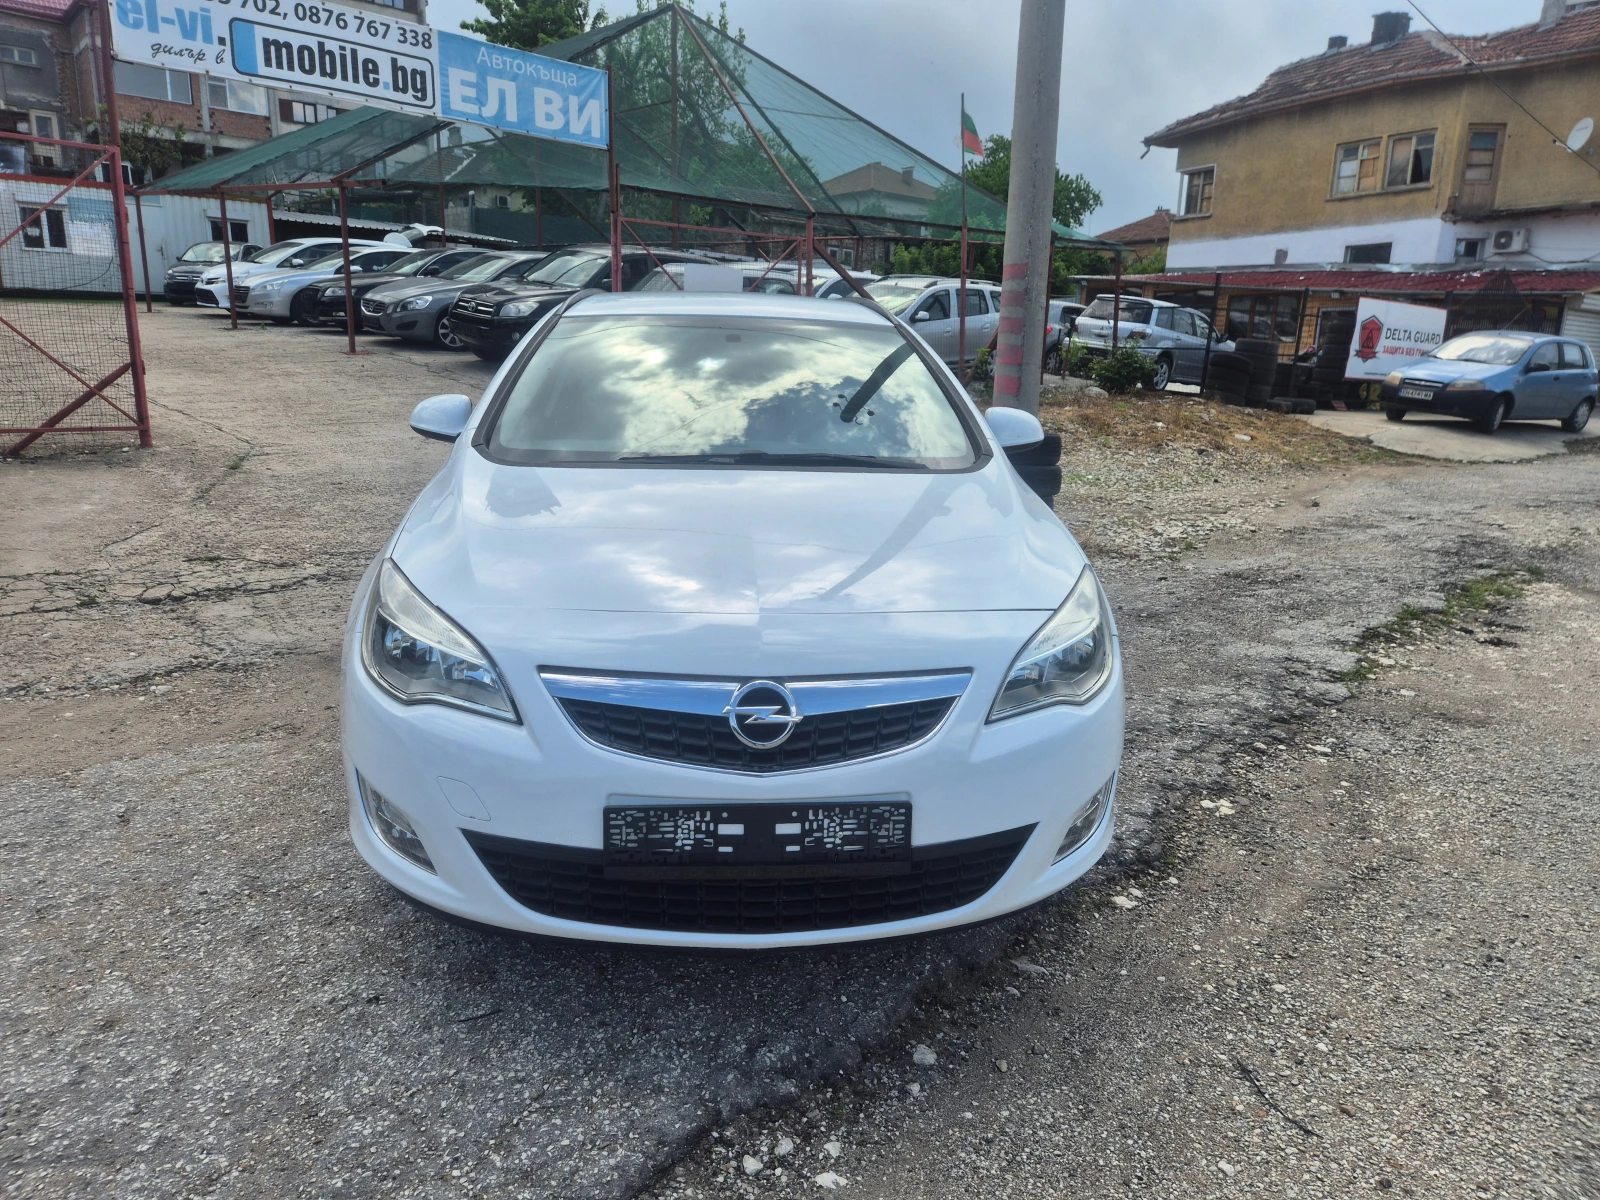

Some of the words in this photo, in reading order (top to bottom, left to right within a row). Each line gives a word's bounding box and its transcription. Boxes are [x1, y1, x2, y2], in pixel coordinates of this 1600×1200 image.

[294, 2, 349, 30] 0876
[353, 14, 391, 40] 767
[397, 26, 433, 50] 338
[262, 36, 428, 102] mobile.bg
[476, 46, 578, 89] Автокъща
[447, 67, 518, 123] ЕЛ
[533, 86, 601, 139] ВИ
[1381, 345, 1405, 356] ЗАЩИТА
[1384, 327, 1412, 343] DELTA
[1413, 331, 1441, 345] GUARD
